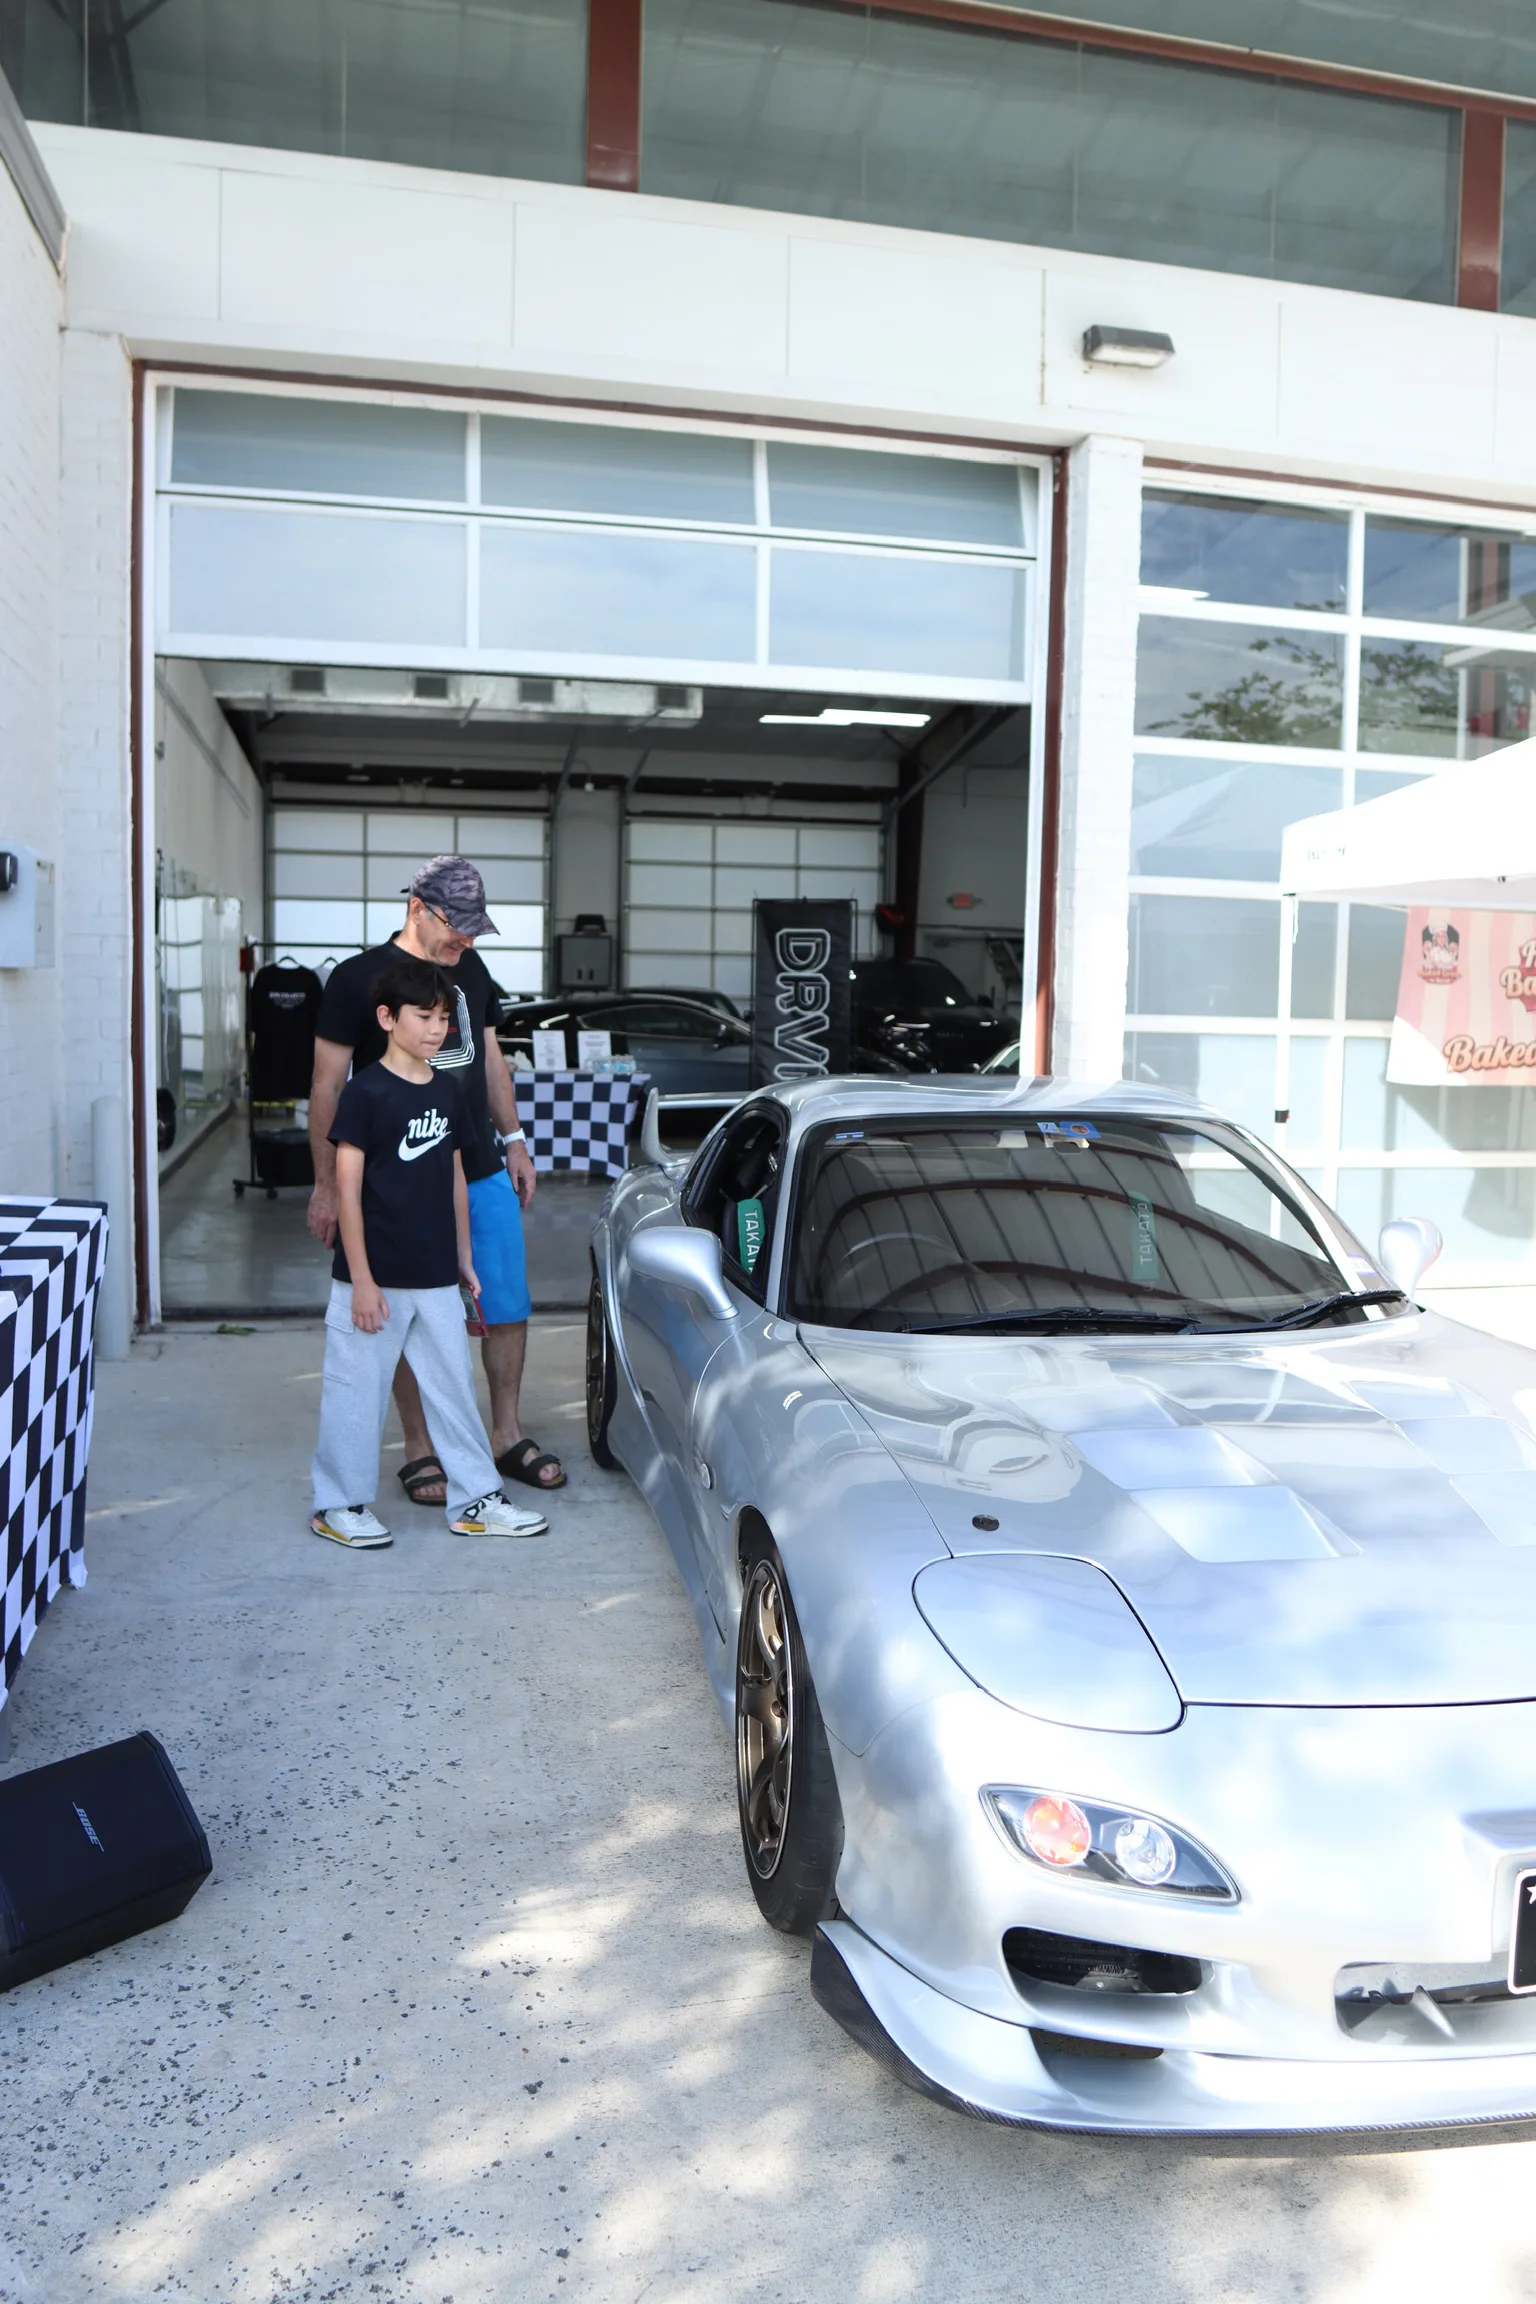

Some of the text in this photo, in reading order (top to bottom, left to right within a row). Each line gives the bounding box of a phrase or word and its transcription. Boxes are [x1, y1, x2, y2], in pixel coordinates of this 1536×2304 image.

[407, 1108, 449, 1139] nike
[1137, 1202, 1153, 1266] TAKATA
[76, 1806, 99, 1846] BOSE
